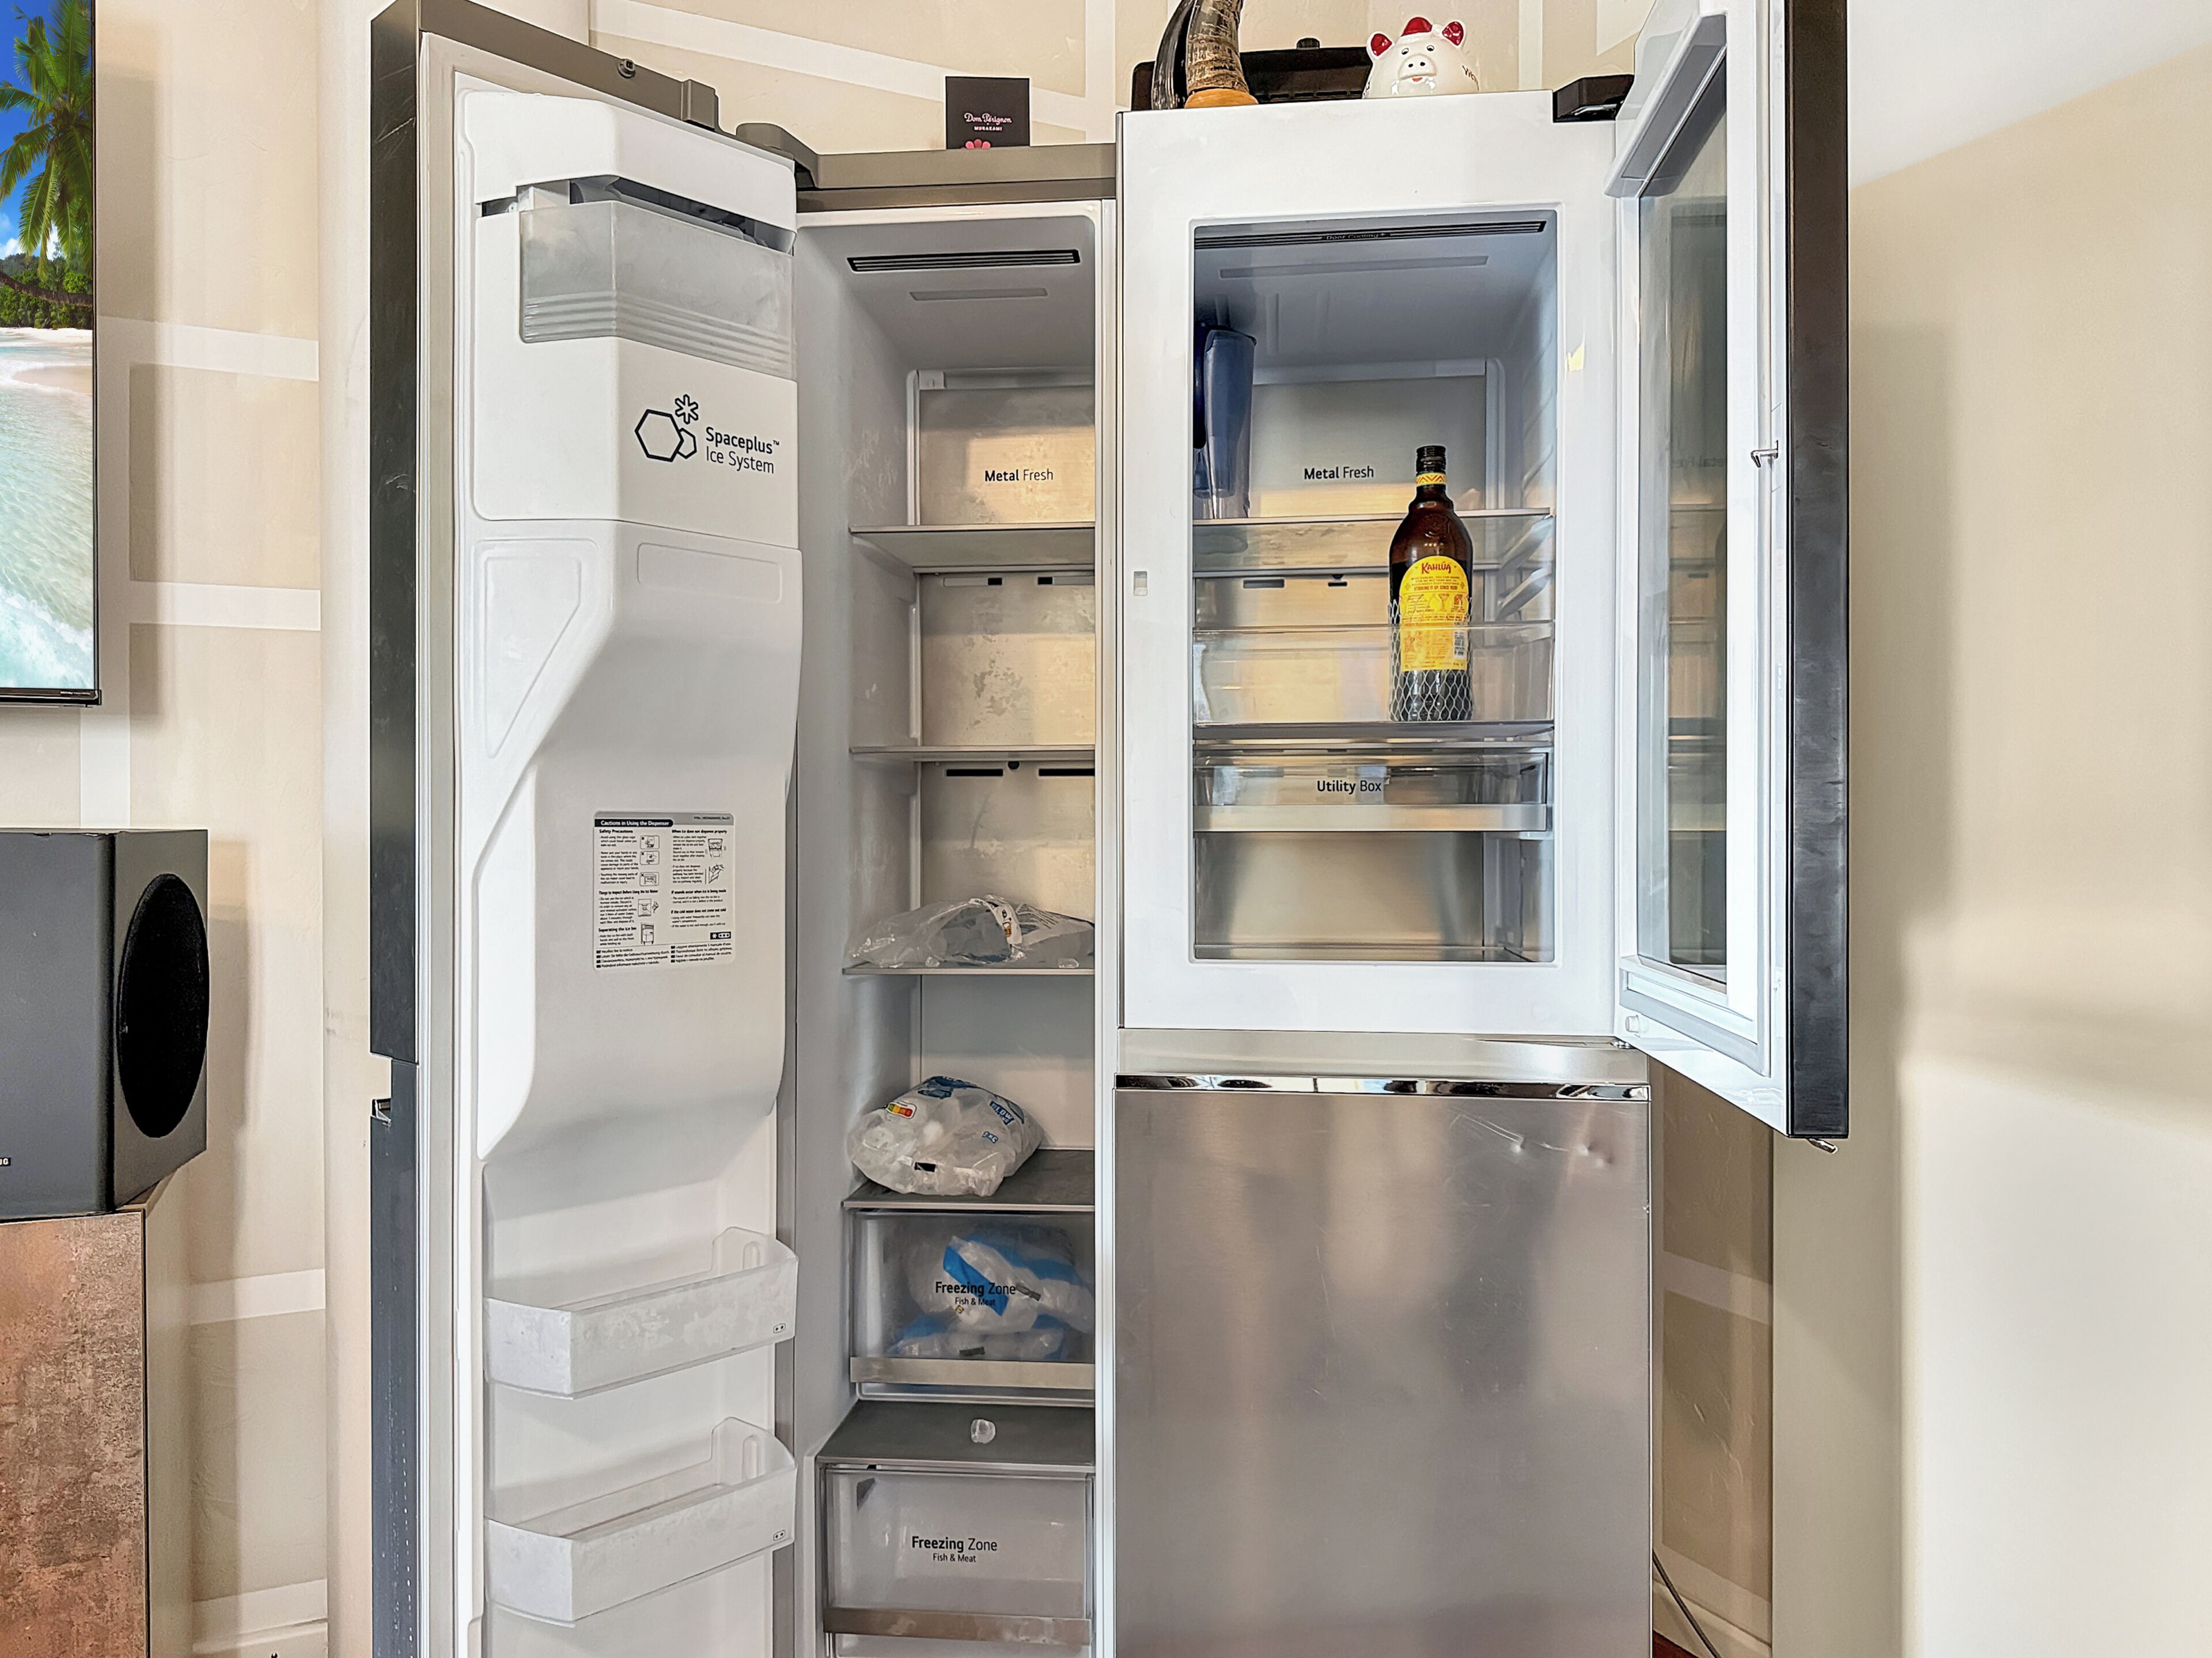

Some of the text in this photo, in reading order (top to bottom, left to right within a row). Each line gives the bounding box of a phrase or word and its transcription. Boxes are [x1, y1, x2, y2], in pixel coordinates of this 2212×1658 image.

[964, 112, 982, 122] Dom
[706, 446, 774, 474] Ice System
[984, 468, 1054, 482] Metal Fresh
[1304, 465, 1374, 480] Metal Fresh
[1317, 780, 1381, 795] Utility Box
[935, 1281, 1016, 1297] Freezing Zone
[955, 1297, 969, 1305] Fish
[979, 1298, 996, 1306] Meat
[912, 1536, 998, 1553] Freezing Zone
[933, 1553, 977, 1563] Fish & Meat
